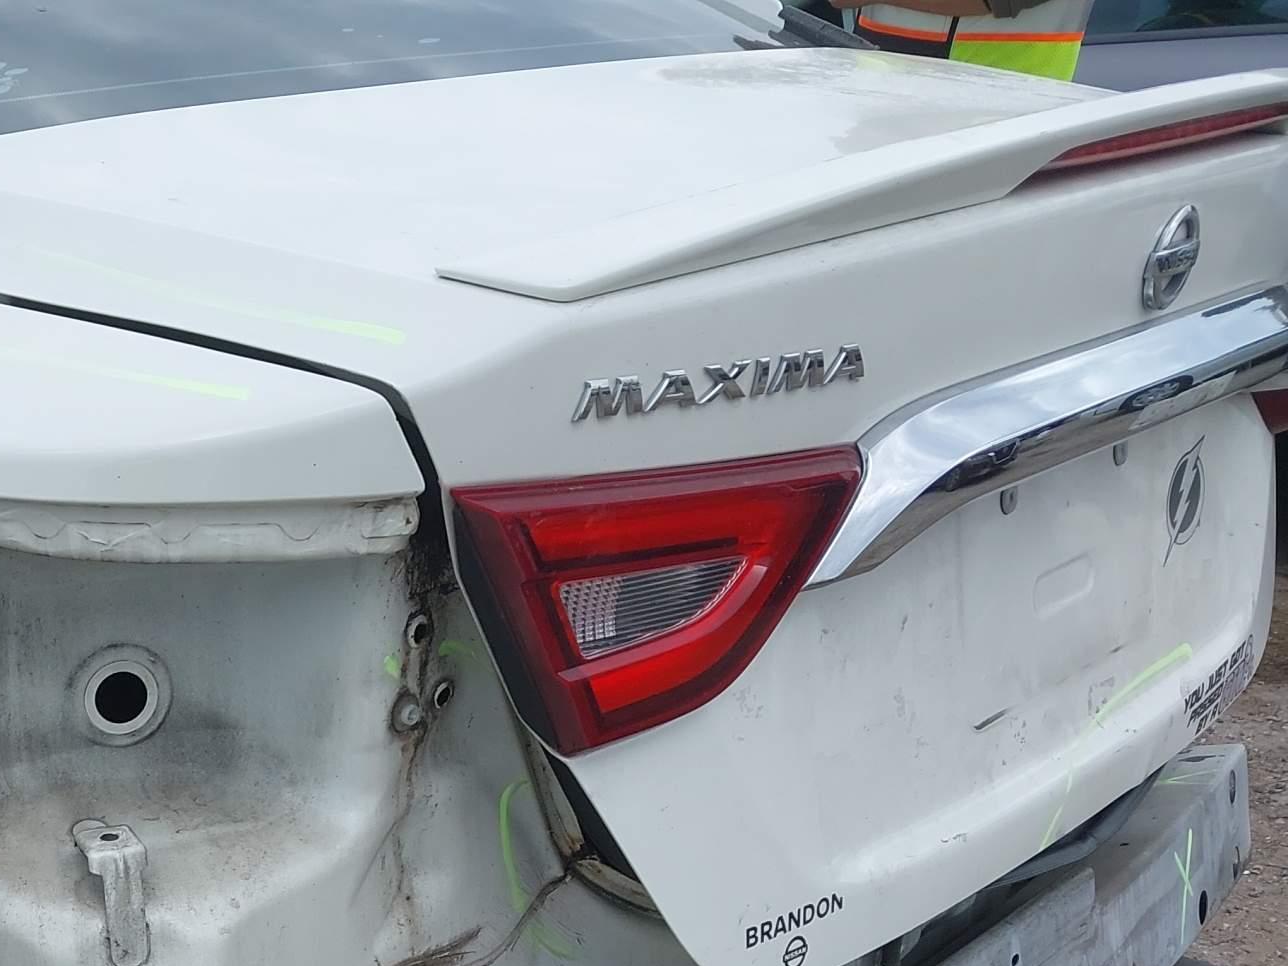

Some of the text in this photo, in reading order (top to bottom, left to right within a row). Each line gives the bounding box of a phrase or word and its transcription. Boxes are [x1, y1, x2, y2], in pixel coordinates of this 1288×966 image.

[571, 343, 865, 423] MAXIMA
[1184, 682, 1205, 715] YOU
[1205, 659, 1229, 694] JUST
[1229, 640, 1246, 671] GOT
[746, 893, 843, 949] BRANDON
